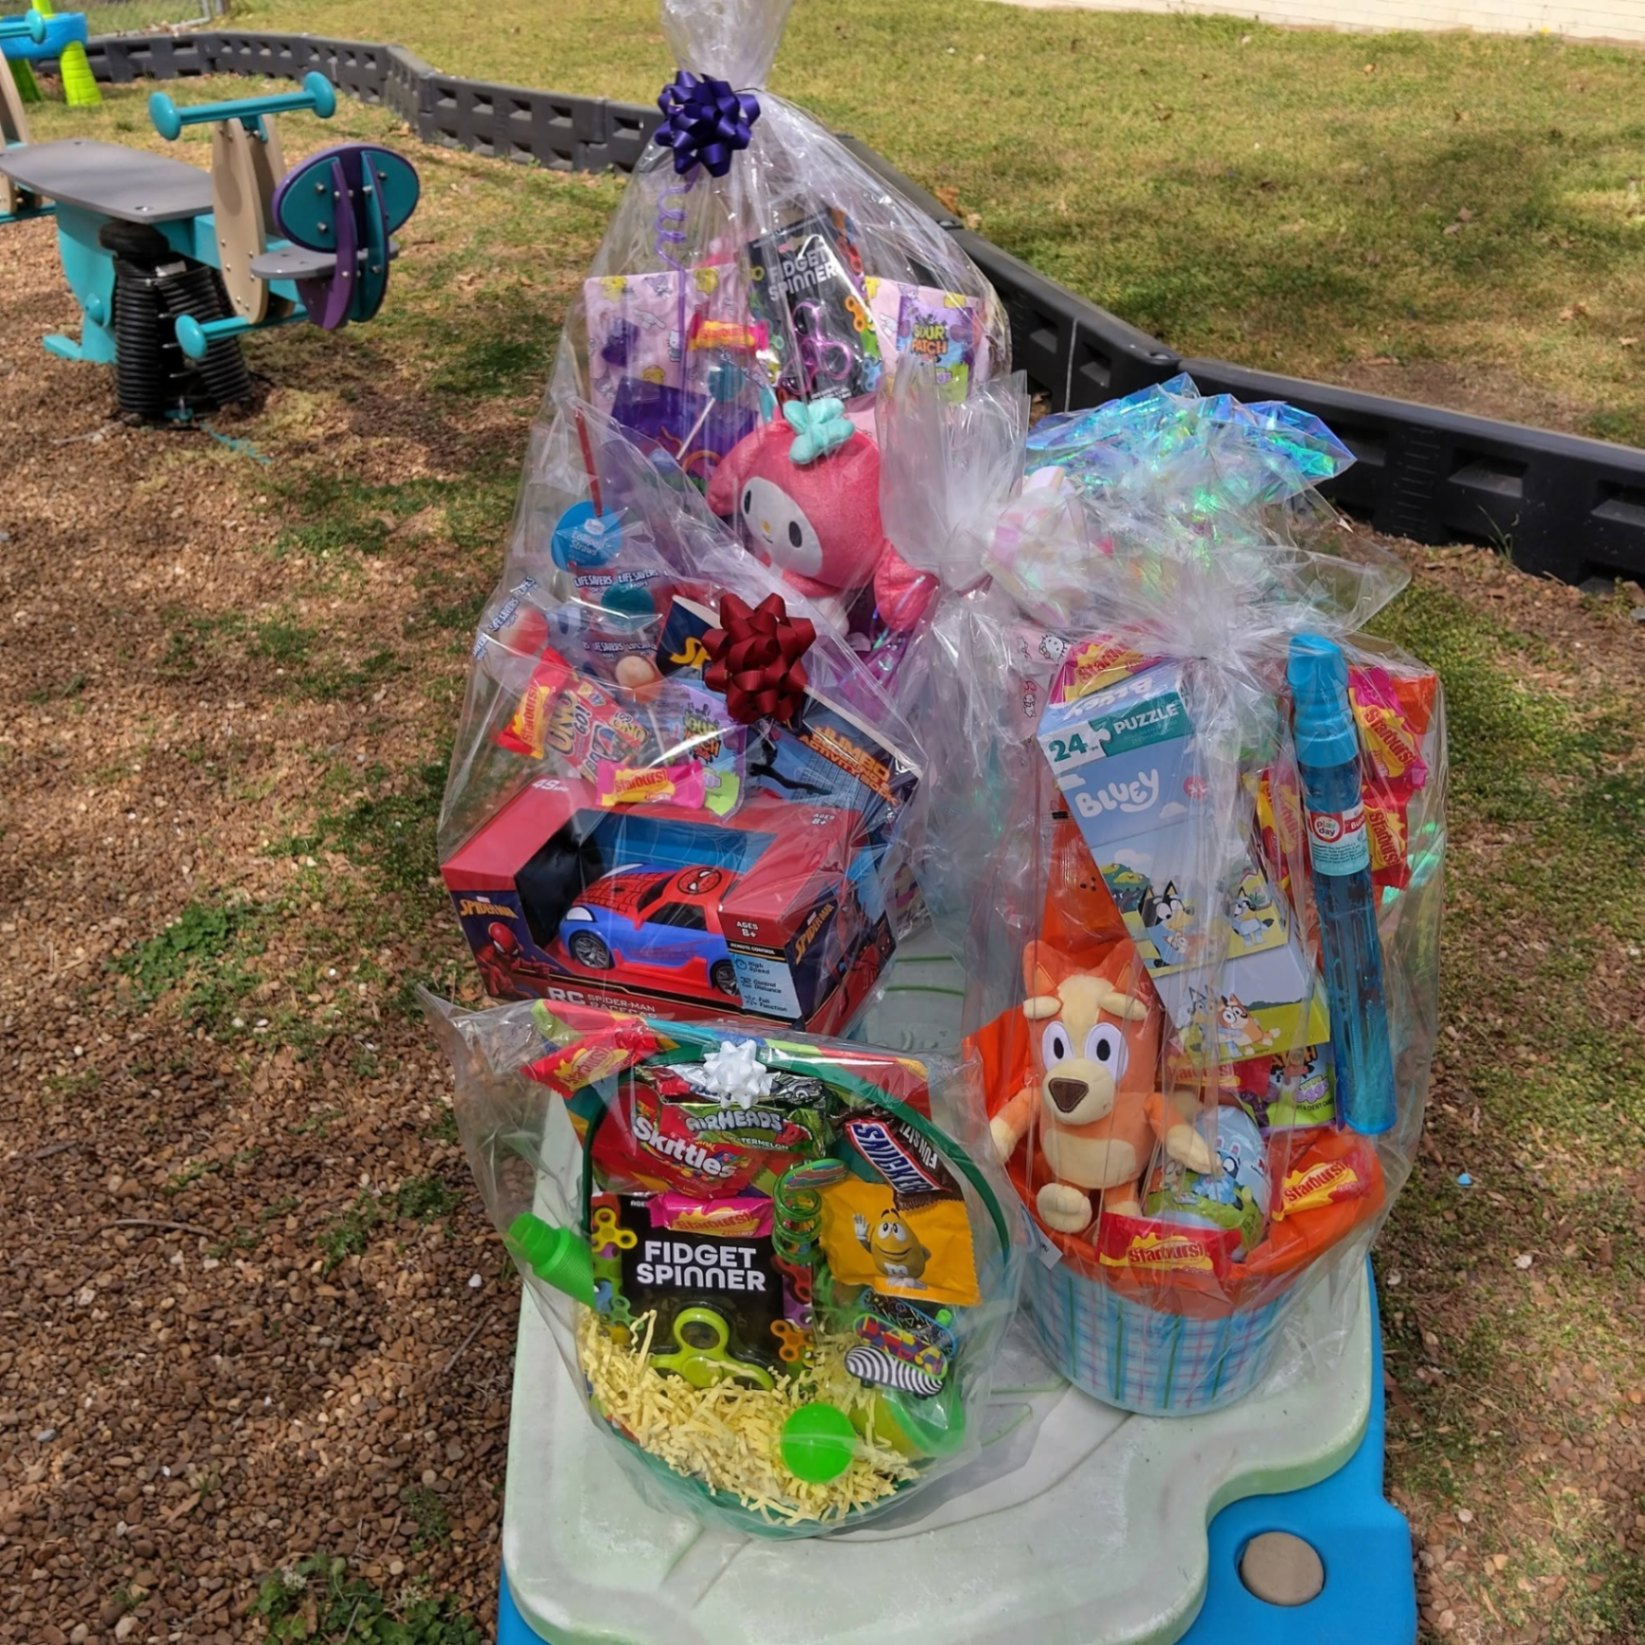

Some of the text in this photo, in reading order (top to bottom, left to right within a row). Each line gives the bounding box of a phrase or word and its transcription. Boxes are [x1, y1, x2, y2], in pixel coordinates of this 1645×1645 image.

[768, 261, 837, 301] SPINNER
[913, 322, 946, 340] SOUR
[546, 688, 582, 756] UNO
[1113, 703, 1179, 735] PUZZLE
[1048, 732, 1089, 762] 24
[736, 921, 759, 931] AGES
[587, 993, 656, 1013] SPIDER-MAN
[686, 1109, 783, 1133] AIRHEADS
[633, 1115, 737, 1179] Skittles
[737, 1136, 790, 1150] TERMELON
[1284, 1160, 1349, 1201] Starburst
[644, 1240, 757, 1268] FIDGET
[1128, 1242, 1205, 1263] Starburst
[636, 1262, 767, 1291] SPINNER
